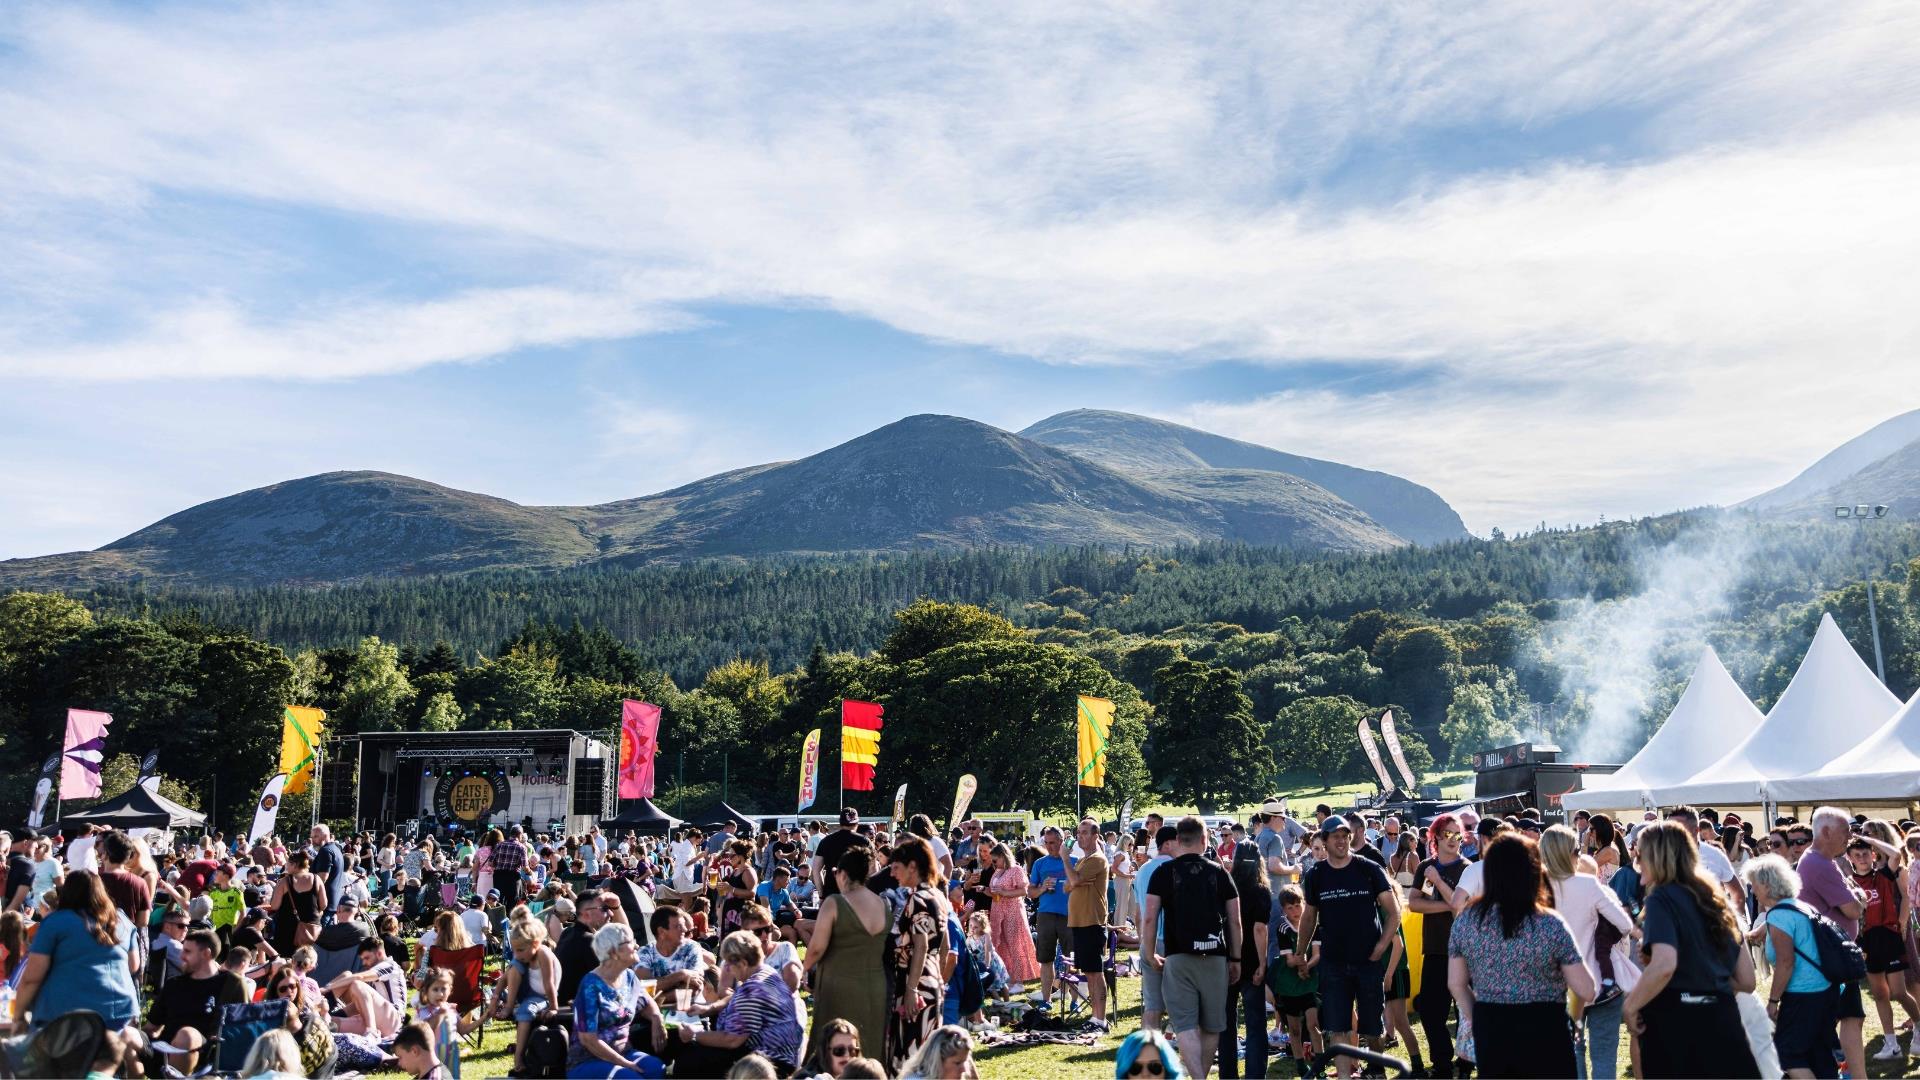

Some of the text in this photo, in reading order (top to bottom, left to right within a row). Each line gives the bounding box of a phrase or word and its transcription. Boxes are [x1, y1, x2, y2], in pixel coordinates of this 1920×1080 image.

[803, 741, 816, 800] SLUSH
[456, 784, 482, 798] EATS
[454, 797, 489, 812] BEATS
[720, 864, 734, 880] 10
[1193, 940, 1218, 950] PUMA
